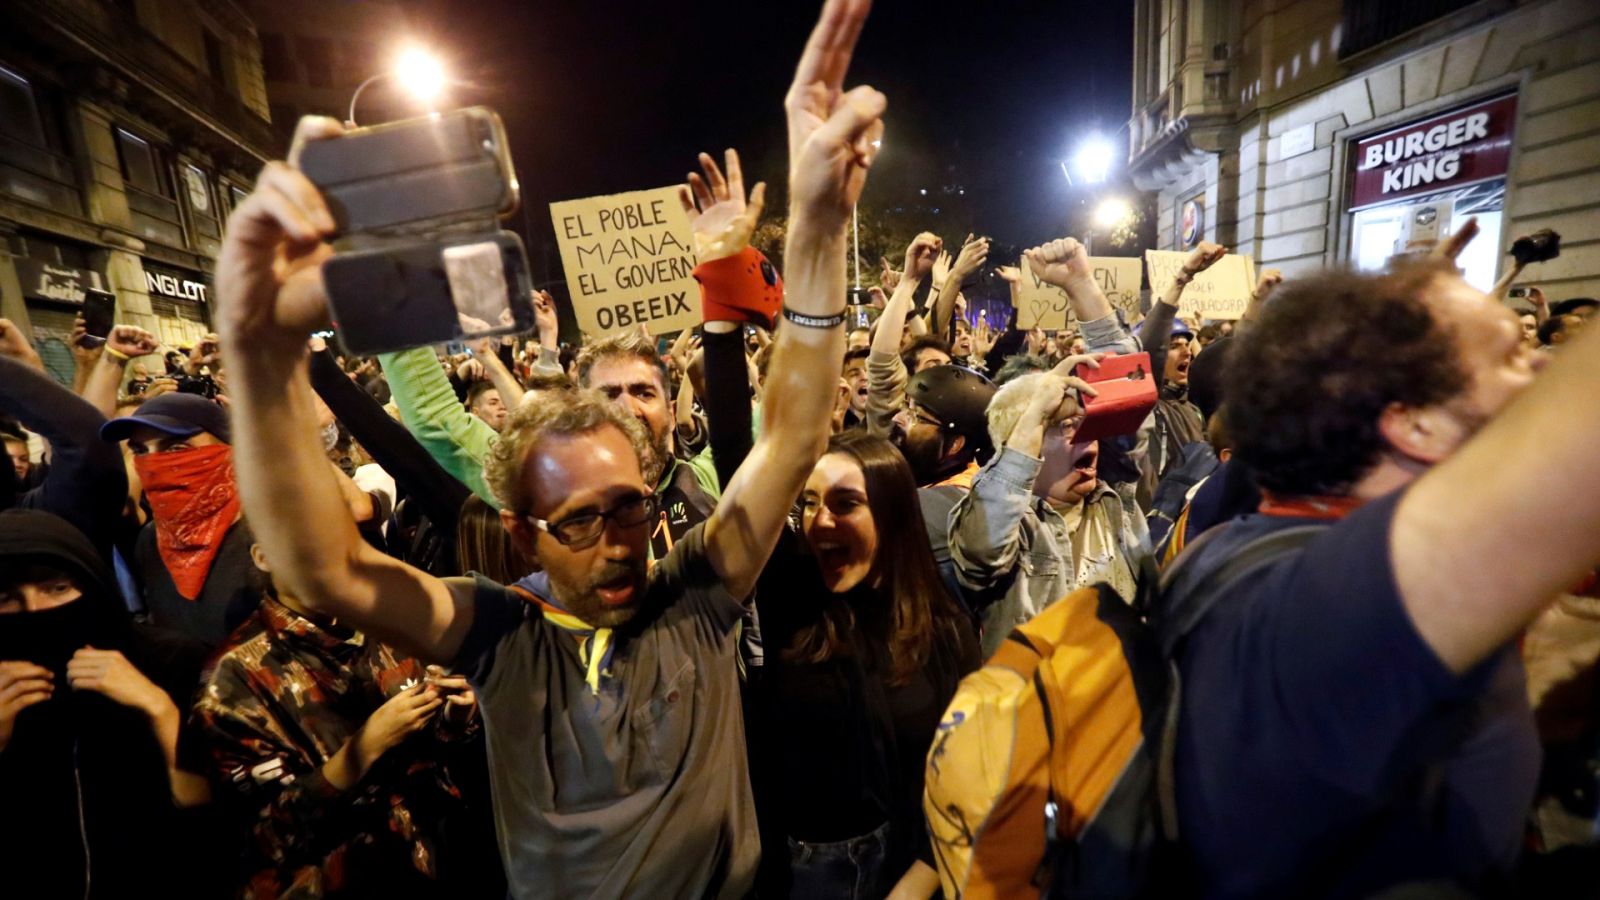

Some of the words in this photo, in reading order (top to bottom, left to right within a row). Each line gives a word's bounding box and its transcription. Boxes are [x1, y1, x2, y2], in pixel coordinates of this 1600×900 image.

[1364, 112, 1489, 170] BURGER
[1382, 154, 1461, 194] KING
[563, 214, 592, 240] EL
[600, 200, 667, 233] POBLE
[576, 230, 692, 269] MANA,
[578, 273, 607, 297] EL
[615, 254, 698, 290] GOVERN
[596, 291, 692, 330] OBEEIX
